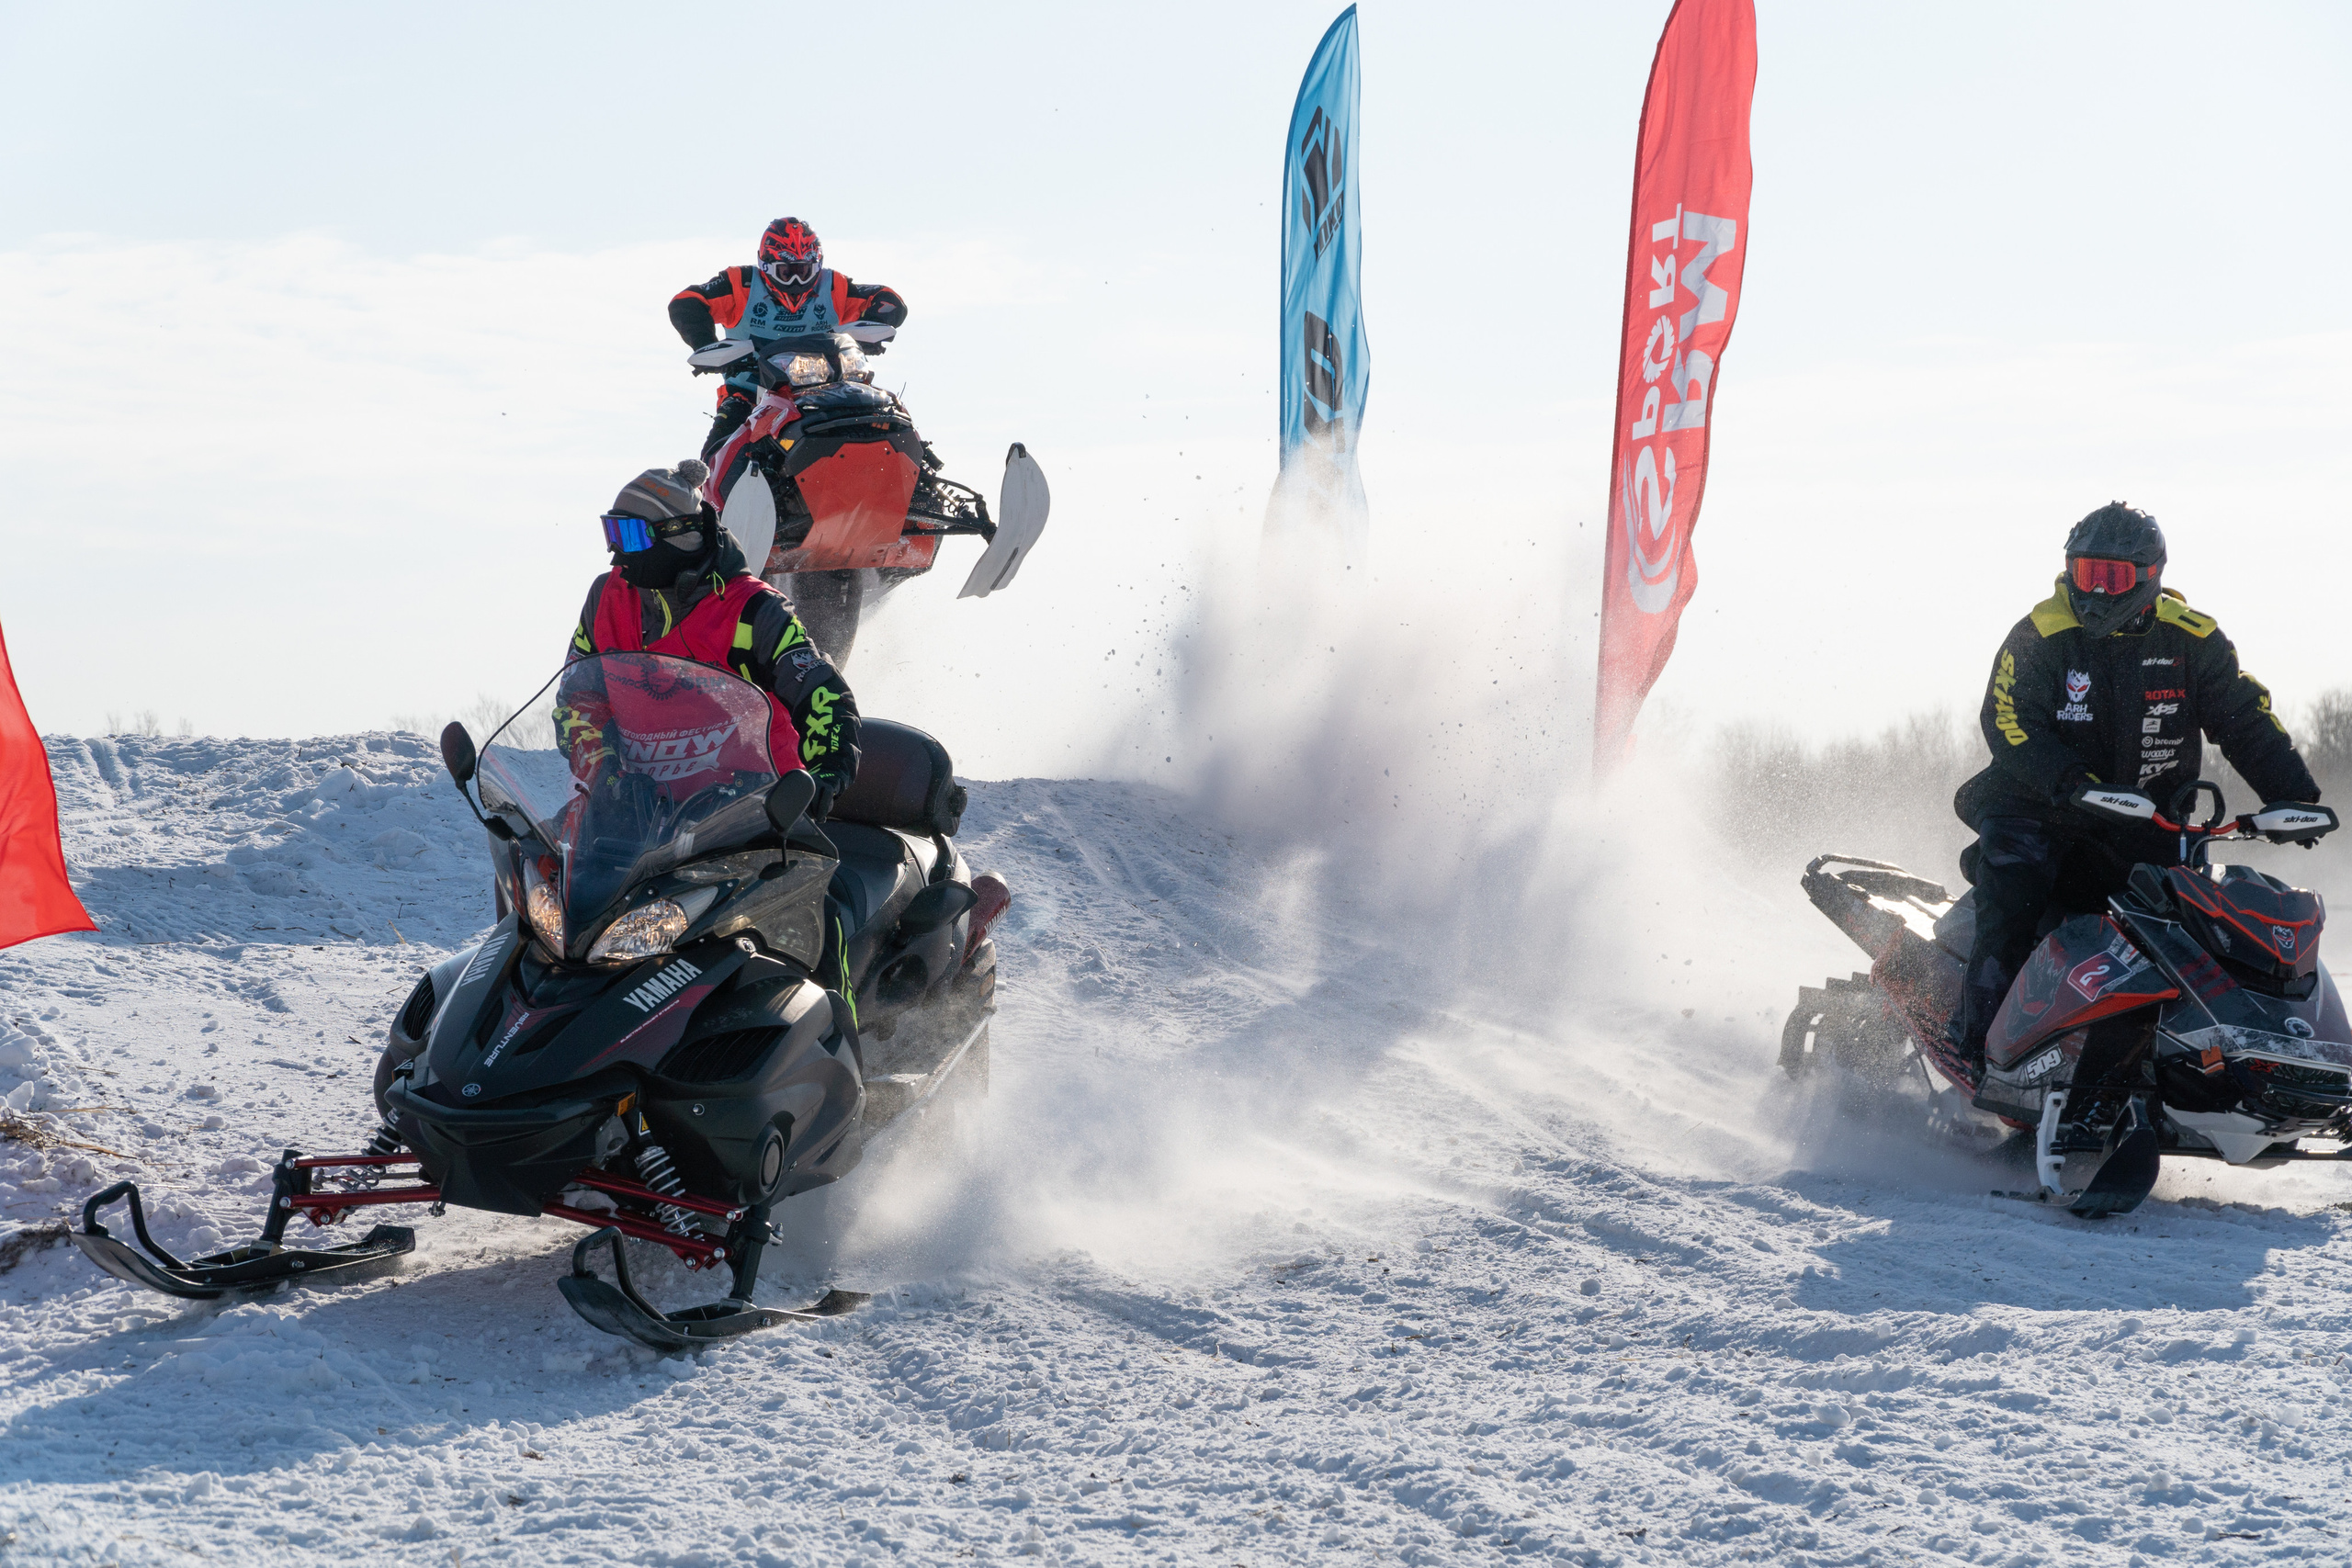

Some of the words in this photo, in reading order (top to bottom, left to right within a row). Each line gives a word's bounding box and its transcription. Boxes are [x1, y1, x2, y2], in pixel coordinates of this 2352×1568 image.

[750, 318, 766, 326] RM
[2142, 657, 2175, 666] ski-doo
[2144, 689, 2186, 701] ROTAX
[2064, 703, 2088, 714] ARH
[2145, 702, 2180, 716] XPS
[2056, 710, 2094, 722] RIDERS
[2100, 795, 2140, 809] ski-doo
[2283, 816, 2319, 824] ski-doo
[460, 931, 512, 987] YAMAHA
[2079, 964, 2111, 987] 2
[623, 958, 704, 1013] YAMAHA
[2027, 1049, 2062, 1080] 509
